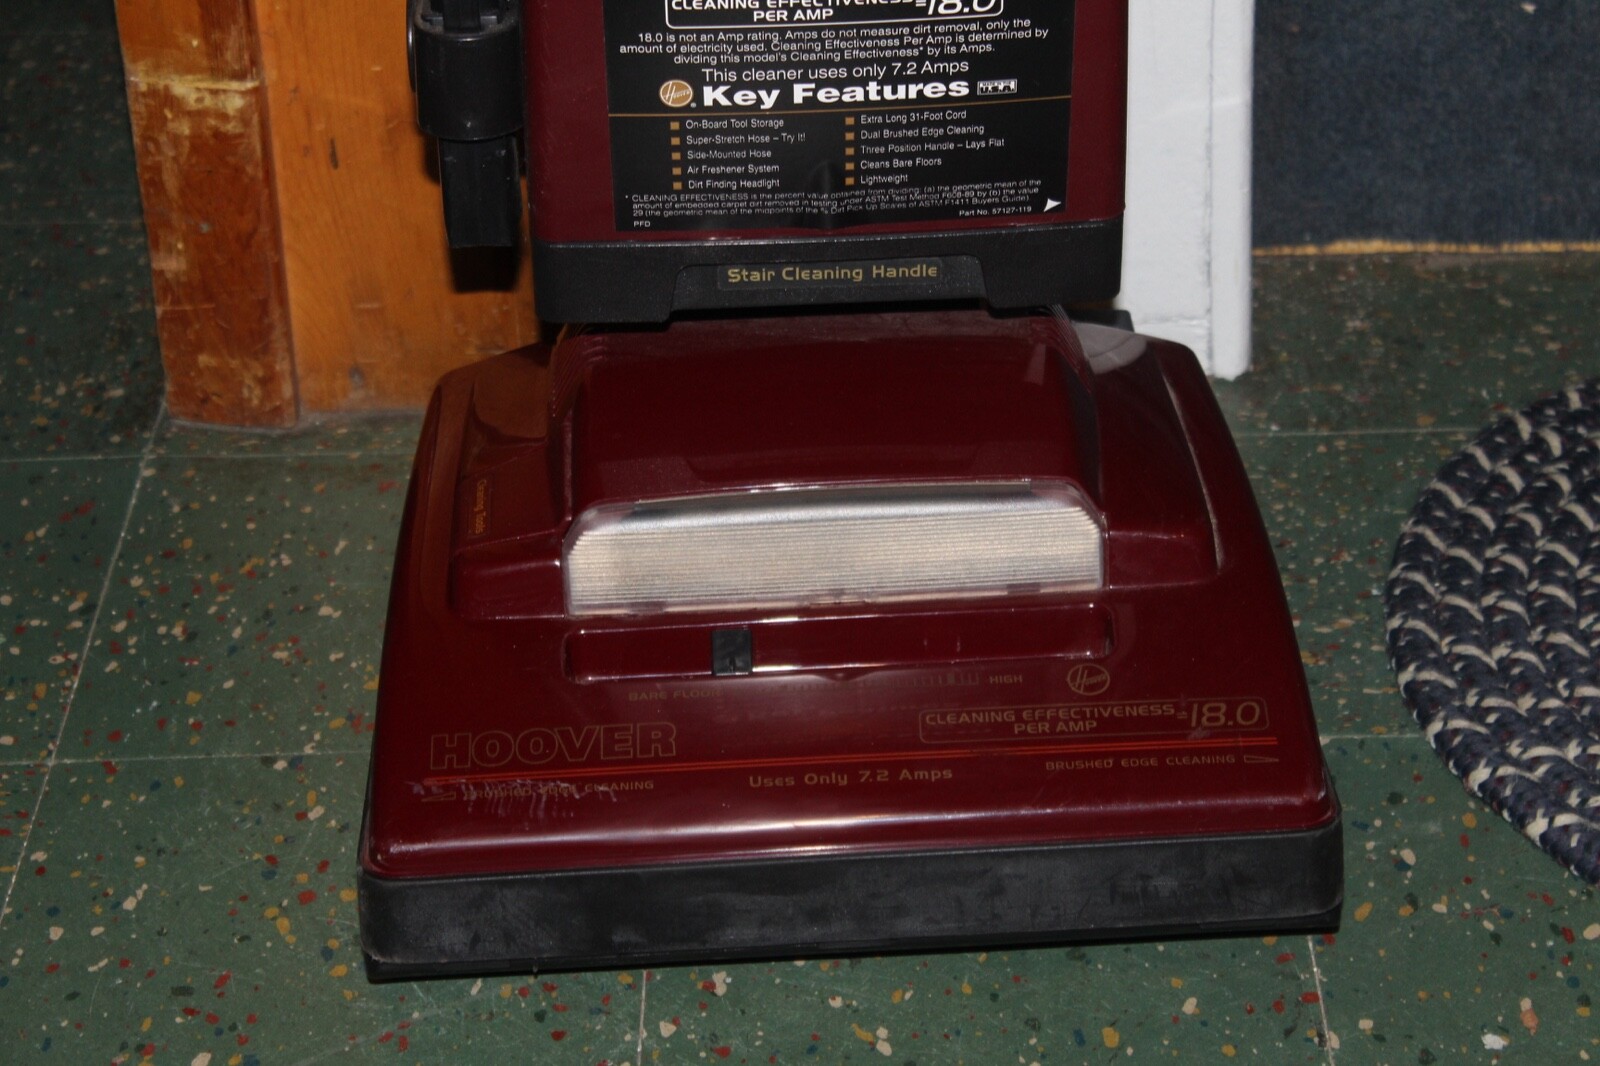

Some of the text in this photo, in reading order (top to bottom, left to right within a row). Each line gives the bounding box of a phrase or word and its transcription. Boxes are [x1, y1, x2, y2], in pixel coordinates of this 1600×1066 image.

[672, 0, 760, 10] CLEANING
[768, 0, 913, 8] EFFECTIV
[753, 9, 833, 22] PER AMP
[639, 33, 662, 43] 18.0
[666, 32, 675, 43] is
[679, 32, 697, 42] not
[700, 34, 715, 42] an
[717, 32, 744, 44] Amp
[747, 30, 781, 44] rating.
[785, 30, 818, 43] Amps
[821, 28, 836, 39] do
[839, 28, 857, 38] not
[860, 27, 910, 37] measure
[913, 24, 931, 35] dirt
[986, 19, 1010, 31] only
[1013, 18, 1031, 28] the
[620, 28, 1049, 55] amount of electricity used. Cleaning Effectiveness Per Amp is determined by
[674, 54, 718, 66] dividing
[720, 54, 740, 63] this
[744, 52, 787, 63] model's
[790, 51, 840, 62] Cleaning
[928, 46, 941, 58] by
[944, 44, 957, 55] its
[960, 43, 996, 54] Amps.
[702, 60, 969, 82] This cleaner uses only 7.2 Amps
[703, 80, 970, 110] Key Features
[686, 118, 784, 130] On-Board Tool Storage
[860, 110, 967, 125] Extra Long 31-Foot Cord
[686, 132, 806, 146] Super-Stretch Hose Try It!
[860, 124, 985, 140] Dual Brushed Edge Cleaning
[860, 138, 1005, 155] Three Position Handle Lays Flat
[688, 149, 772, 160] Side-Mounted Hose
[687, 164, 780, 175] Air Freshener System
[860, 157, 942, 170] Cleans Bare Floors
[688, 179, 780, 191] Dirt Finding Headlight
[860, 174, 909, 186] Lightweight
[632, 194, 678, 203] CLEANING
[680, 192, 749, 202] EFFECTIVENESS
[774, 192, 805, 201] percent
[952, 182, 993, 193] geometric
[994, 181, 1017, 189] mean
[1018, 180, 1027, 188] of
[1028, 179, 1042, 187] the
[633, 202, 663, 210] amount
[664, 202, 673, 210] of
[674, 202, 719, 210] embedded
[764, 200, 800, 209] removed
[811, 199, 838, 209] testing
[865, 194, 889, 203] ASTM
[892, 194, 908, 202] Test
[910, 193, 940, 201] Method
[977, 190, 988, 199] by
[1002, 188, 1016, 196] the
[1018, 187, 1039, 195] value
[663, 209, 703, 218] geometric
[796, 206, 804, 214] of
[908, 201, 917, 209] of
[634, 220, 651, 228] PFD
[728, 264, 938, 283] Stair Cleaning Handle
[990, 674, 1023, 685] HIGH
[628, 690, 668, 701] BARE
[926, 710, 1016, 725] CLEANING
[1022, 704, 1175, 722] EFFECTIVENESS
[1014, 720, 1097, 735] PER AMP
[430, 722, 677, 770] HOOVER
[1046, 754, 1236, 771] BRUSHED EDGE CLEANING
[749, 768, 953, 788] Uses Only 7.2 Amps
[584, 781, 655, 793] CLEANING
